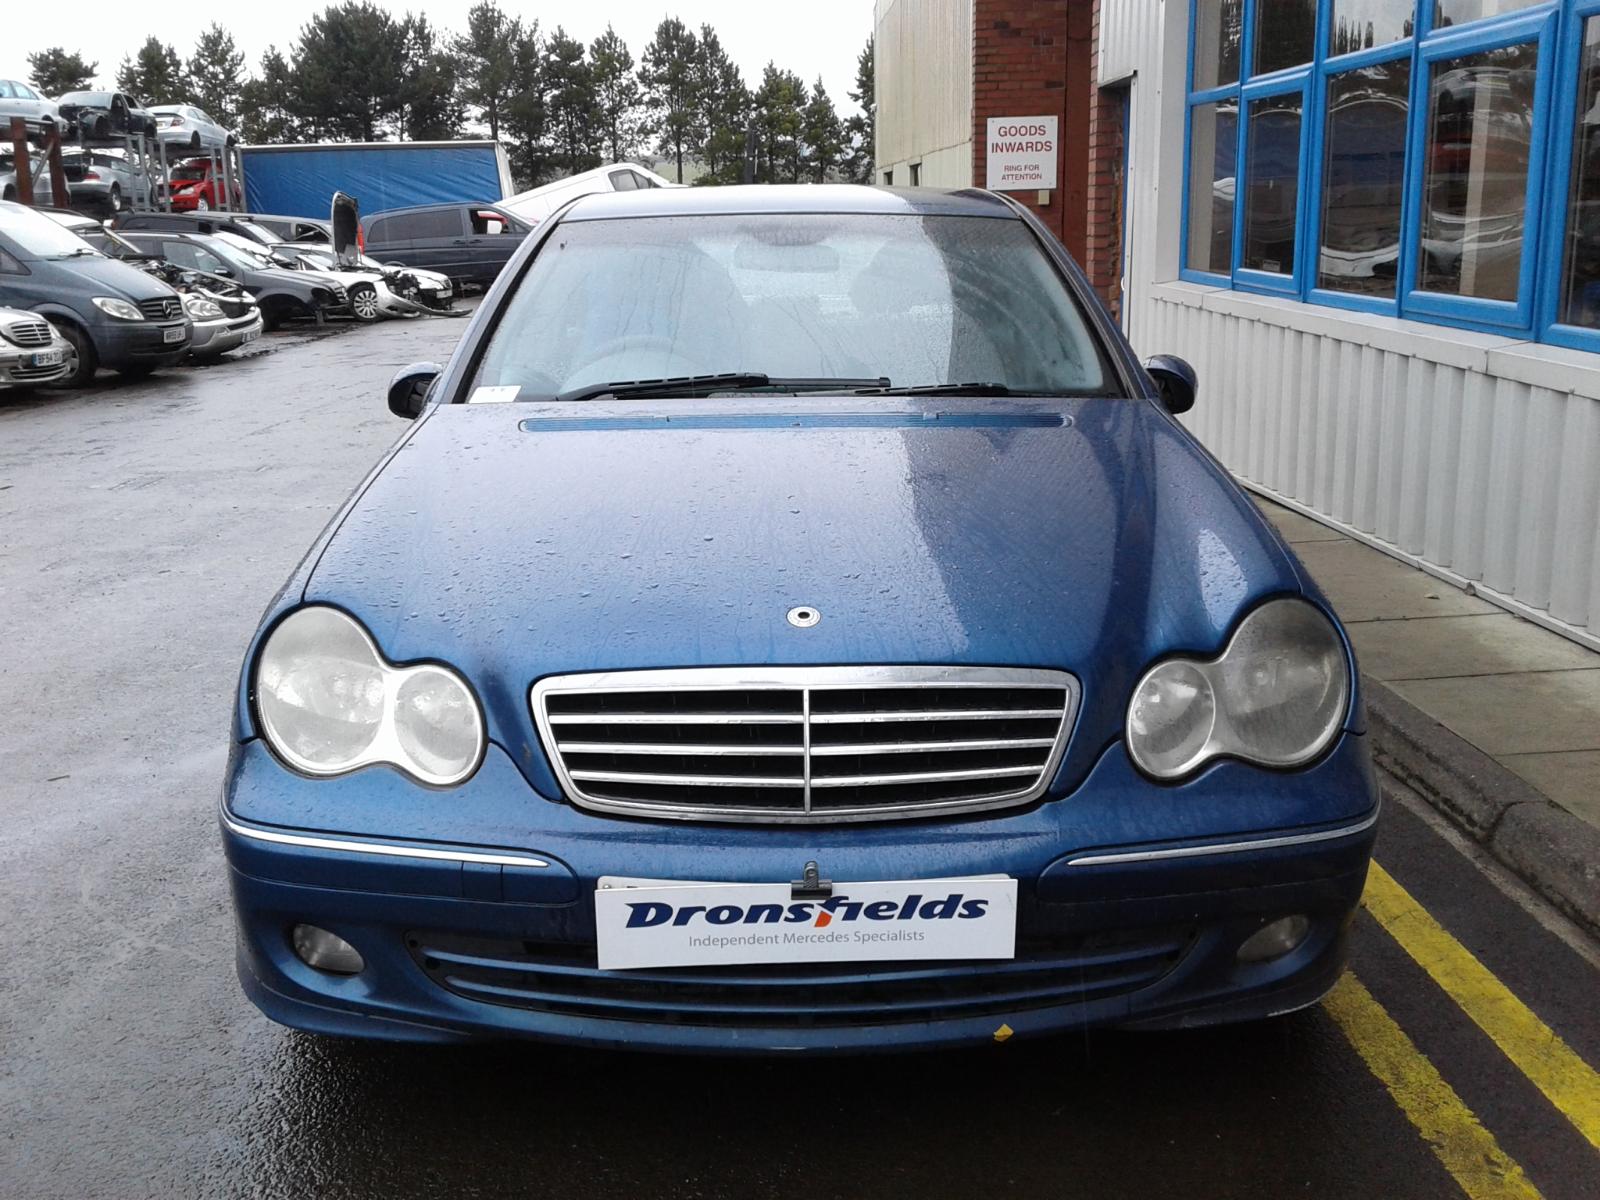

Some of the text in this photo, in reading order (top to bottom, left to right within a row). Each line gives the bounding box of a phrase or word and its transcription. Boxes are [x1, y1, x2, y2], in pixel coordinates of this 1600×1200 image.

[998, 125, 1047, 137] GOODS
[991, 140, 1053, 154] INWARDS
[1003, 164, 1023, 172] RING
[1001, 173, 1042, 181] ATTENTION
[624, 894, 989, 929] Dronsfields
[689, 930, 925, 948] Independent Mercedes Specialists
